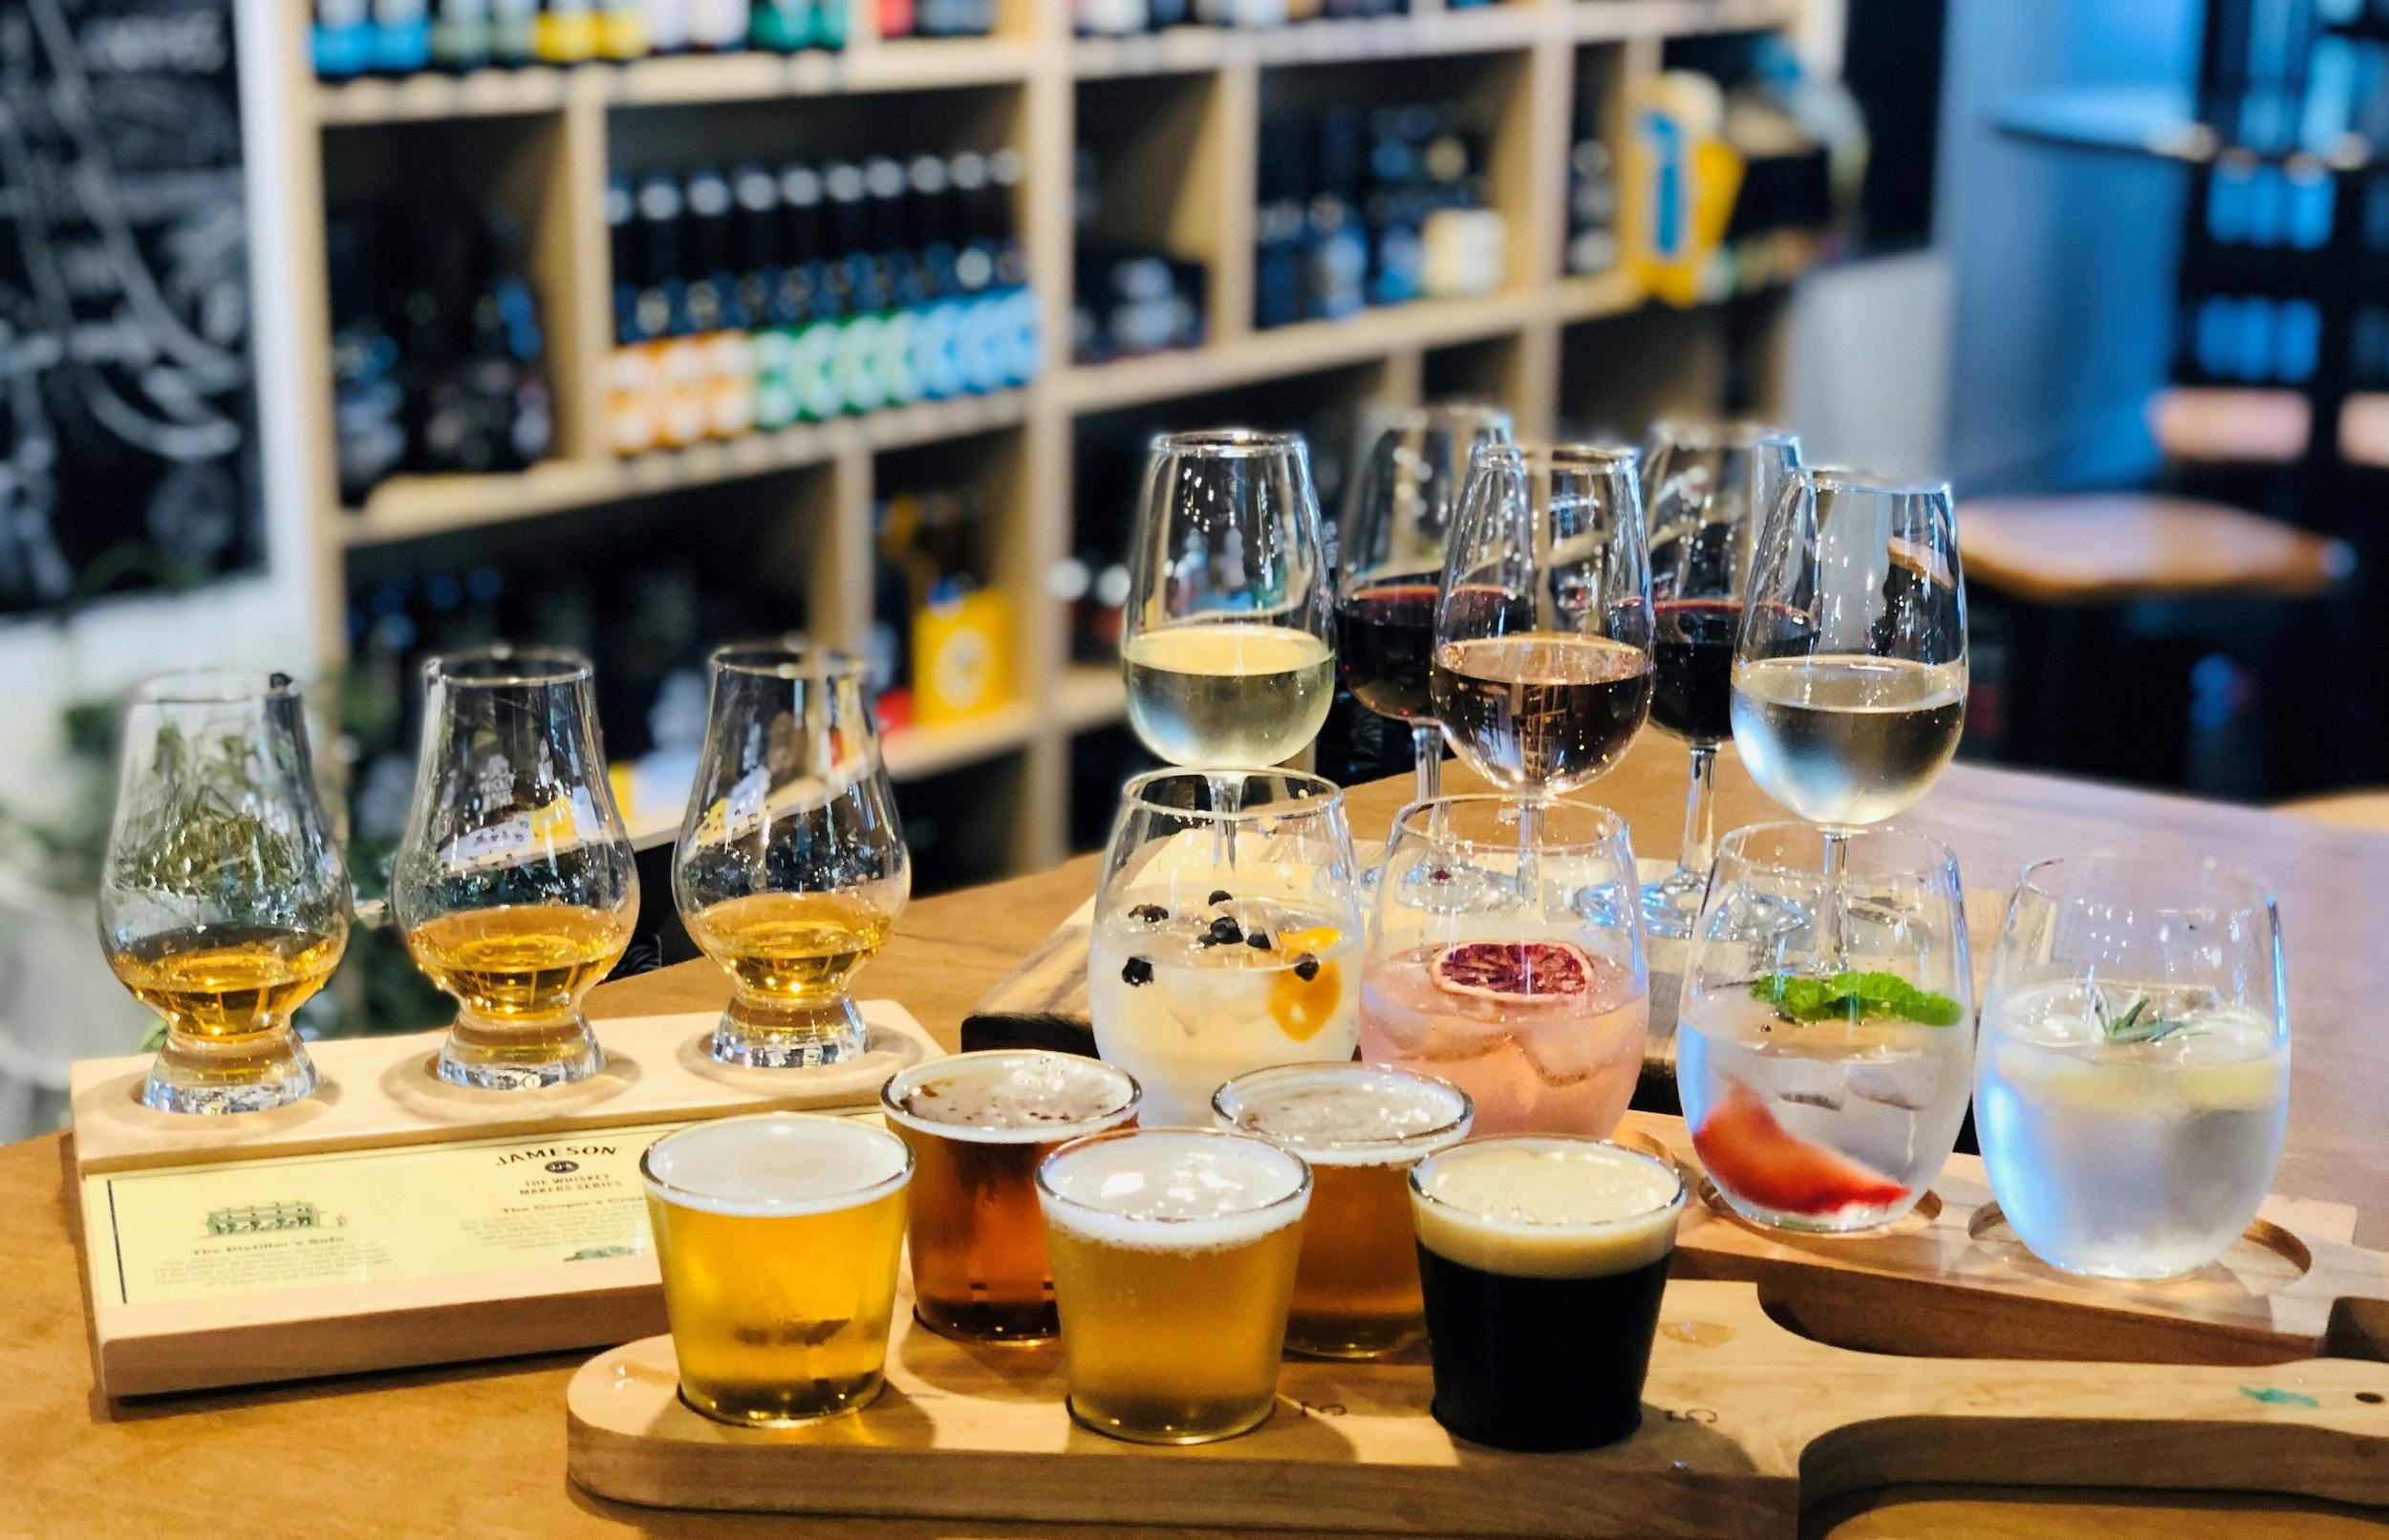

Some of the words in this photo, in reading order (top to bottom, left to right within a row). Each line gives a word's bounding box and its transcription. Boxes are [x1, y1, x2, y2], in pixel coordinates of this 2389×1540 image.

[495, 1145, 618, 1166] JAMESON
[525, 1179, 546, 1187] THE
[552, 1174, 611, 1185] WHISKEY
[576, 1181, 623, 1191] SERIES
